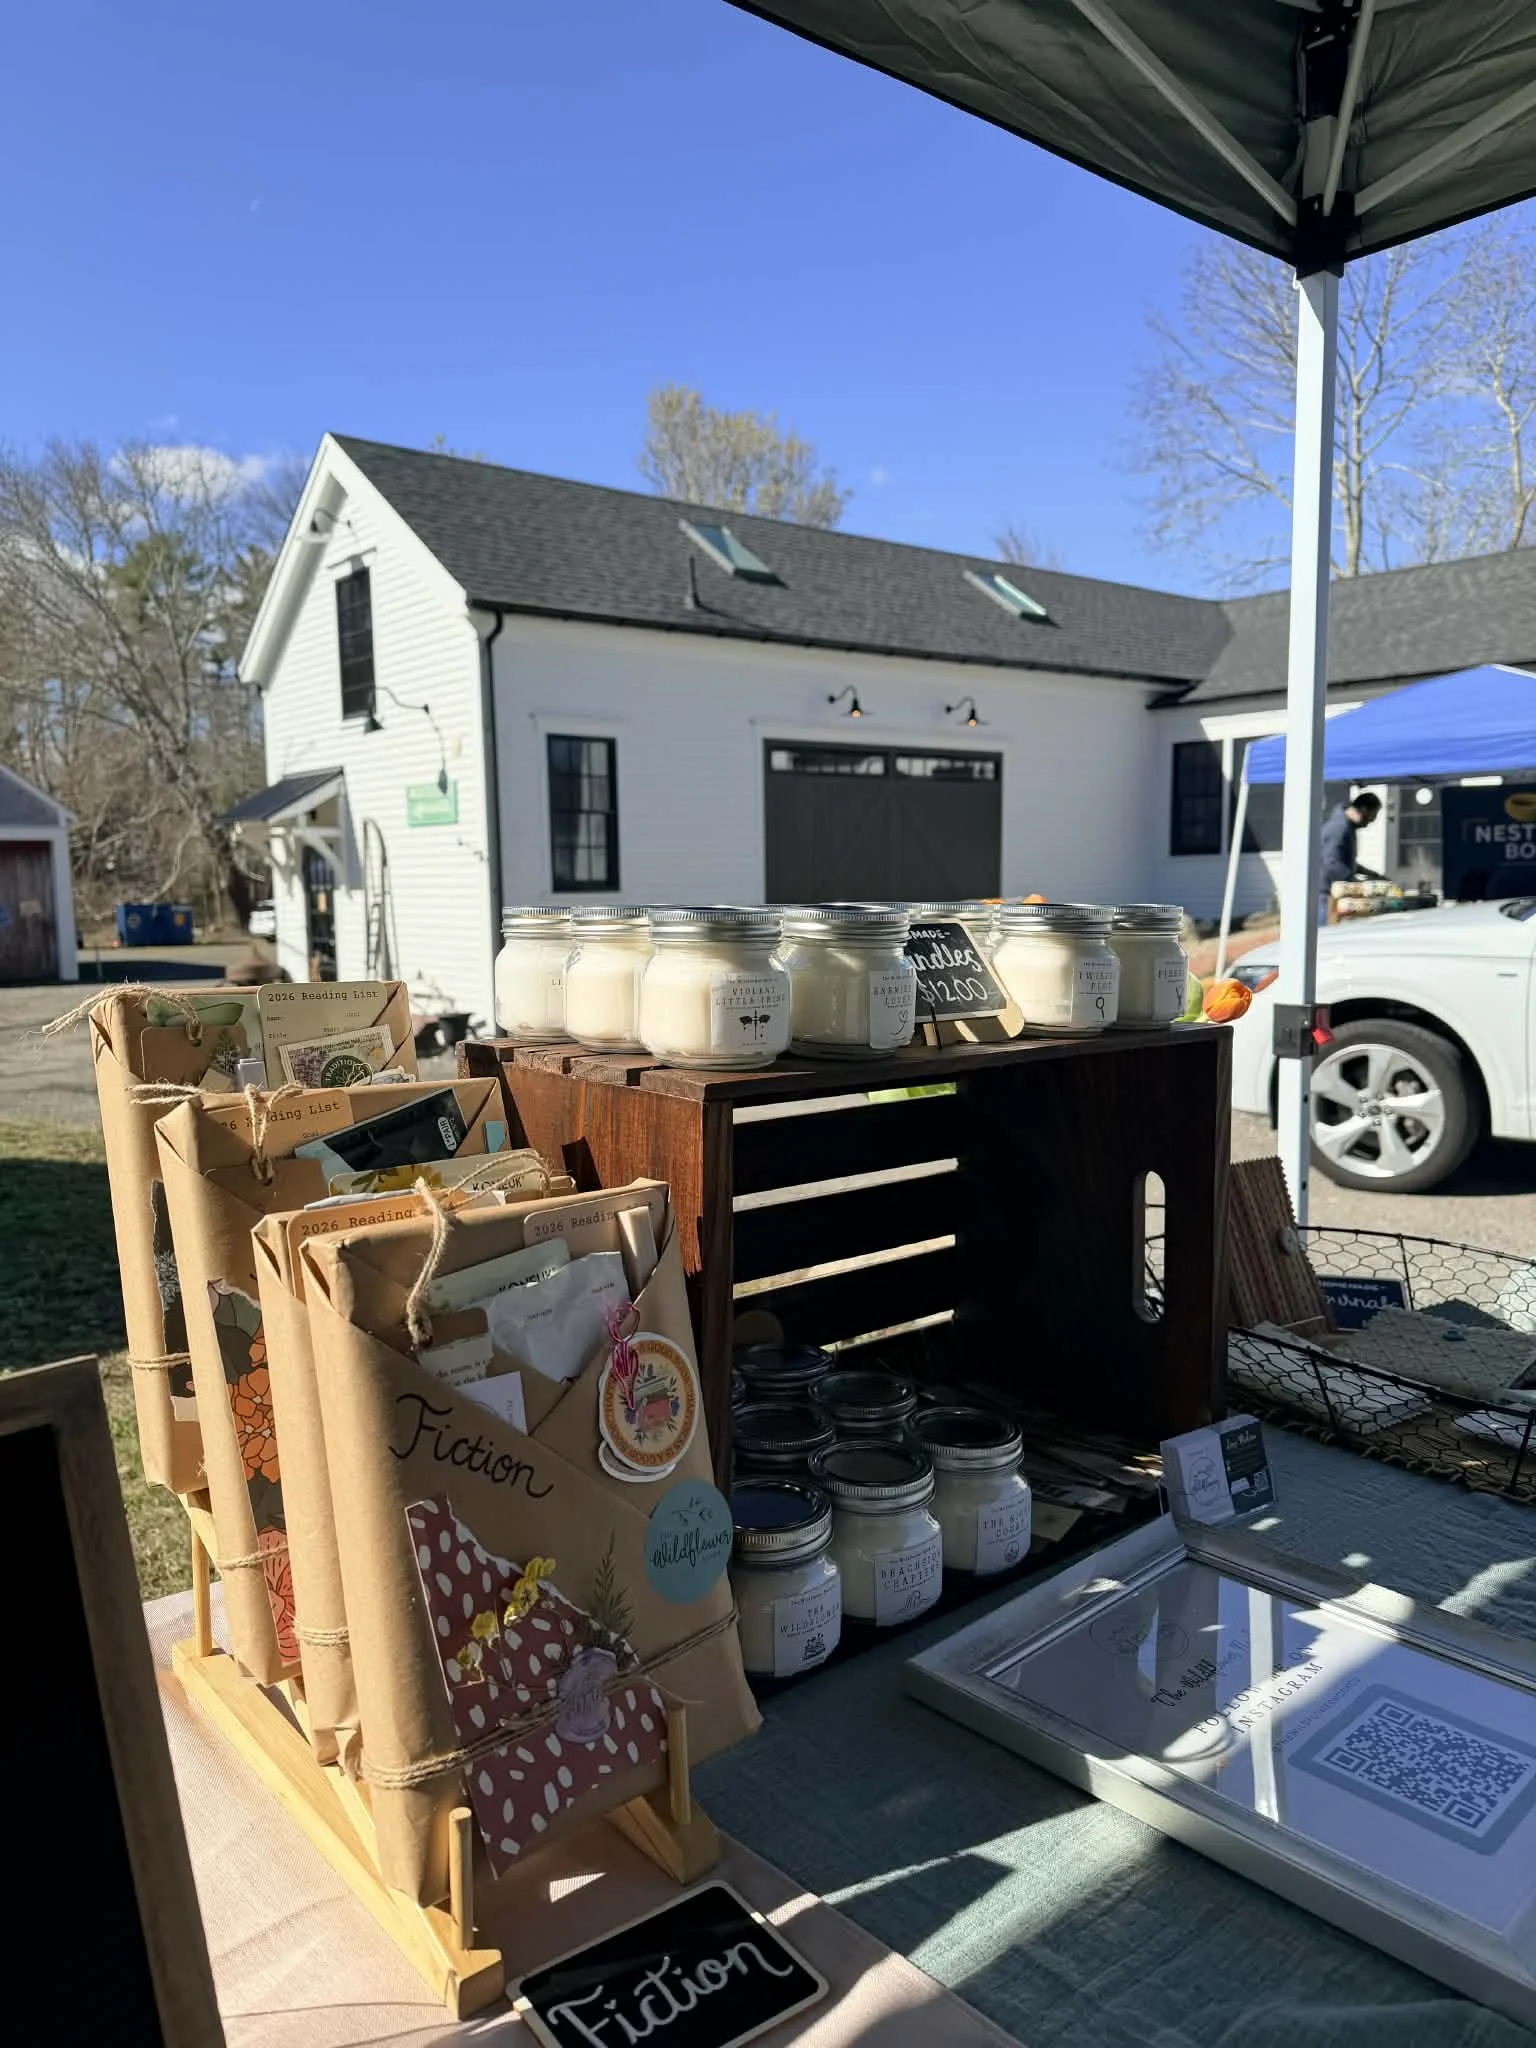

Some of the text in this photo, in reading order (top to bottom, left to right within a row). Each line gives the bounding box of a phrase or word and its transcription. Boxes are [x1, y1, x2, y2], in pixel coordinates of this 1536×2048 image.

[1475, 824, 1536, 843] NEST
[1506, 843, 1536, 859] BO
[268, 990, 379, 1002] 2026 Reading List
[917, 977, 988, 1007] $12.00
[245, 1110, 302, 1128] Rding
[309, 1102, 341, 1116] List
[302, 1221, 339, 1236] 2026
[534, 1211, 622, 1237] 2026 Readin
[389, 1393, 554, 1498] Fiction
[1193, 1685, 1263, 1735] FOLLOW
[1231, 1662, 1323, 1735] INSTAGRAM
[547, 1941, 793, 2048] Fiction
